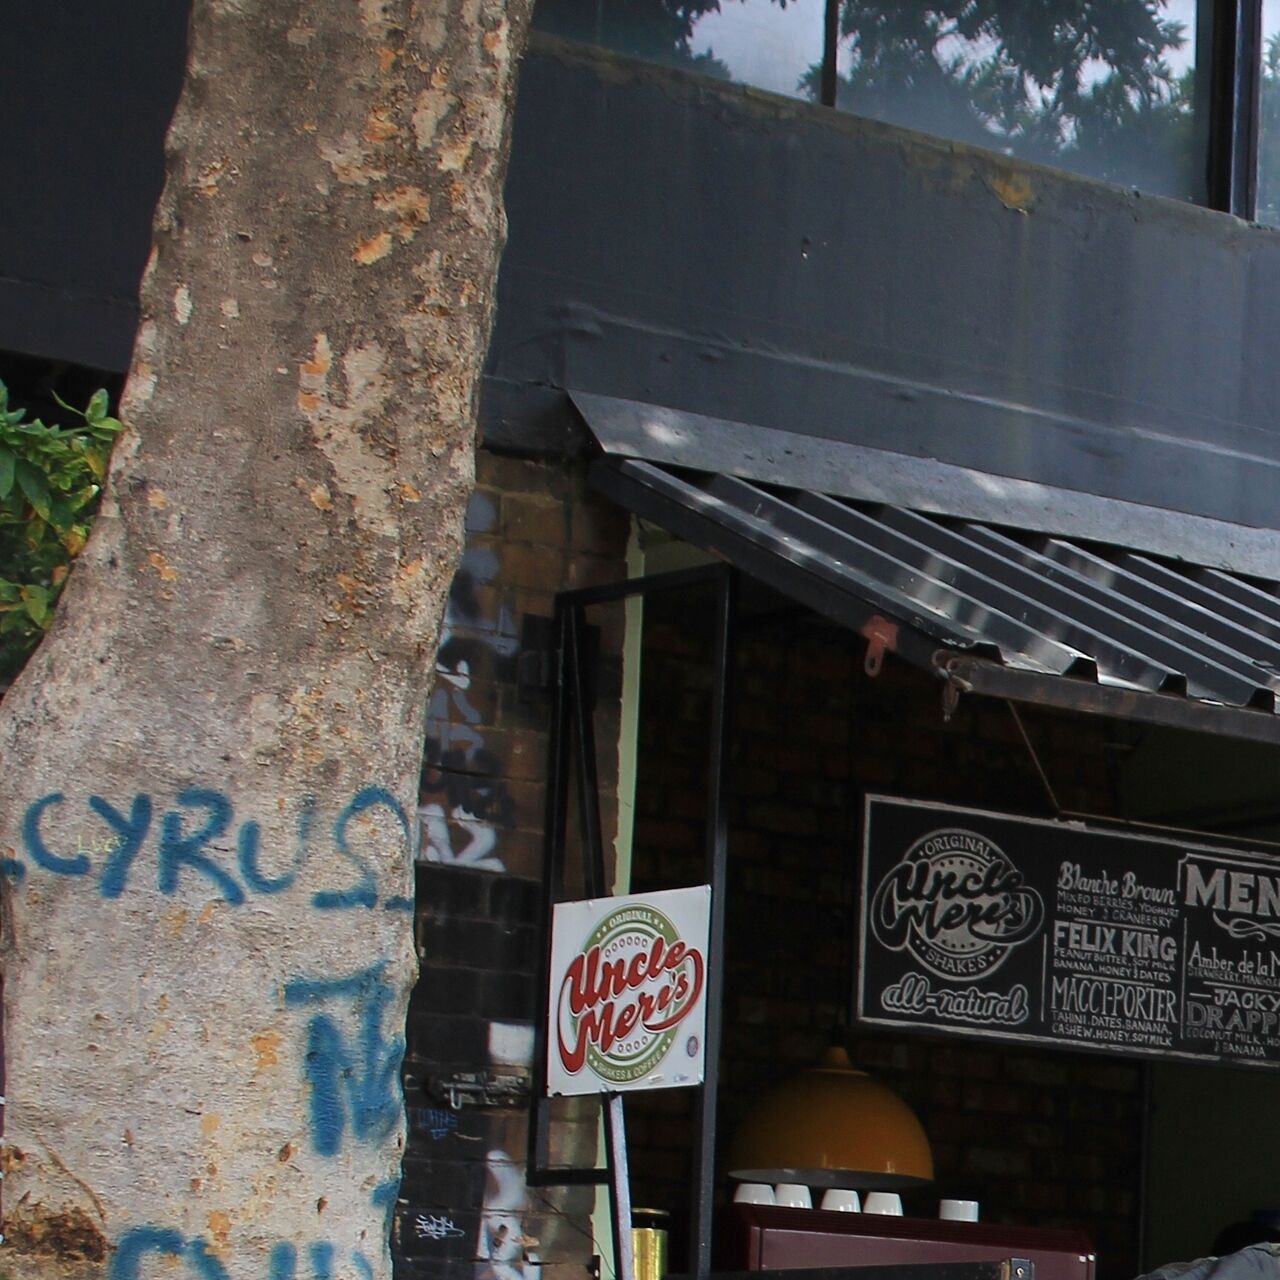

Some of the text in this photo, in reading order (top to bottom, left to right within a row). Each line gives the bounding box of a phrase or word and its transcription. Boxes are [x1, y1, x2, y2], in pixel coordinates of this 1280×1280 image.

[924, 836, 990, 860] ORIGINAL
[876, 859, 1023, 903] Uncle
[1121, 871, 1176, 905] Brown
[1054, 920, 1177, 962] FELIX KING
[1188, 940, 1236, 971] Amber
[1237, 950, 1255, 974] de
[1257, 951, 1269, 976] la
[562, 936, 686, 1015] Uncle
[926, 950, 987, 973] SHAKES
[1139, 970, 1171, 983] DATES
[1051, 975, 1178, 1024] MACCI-PORTER
